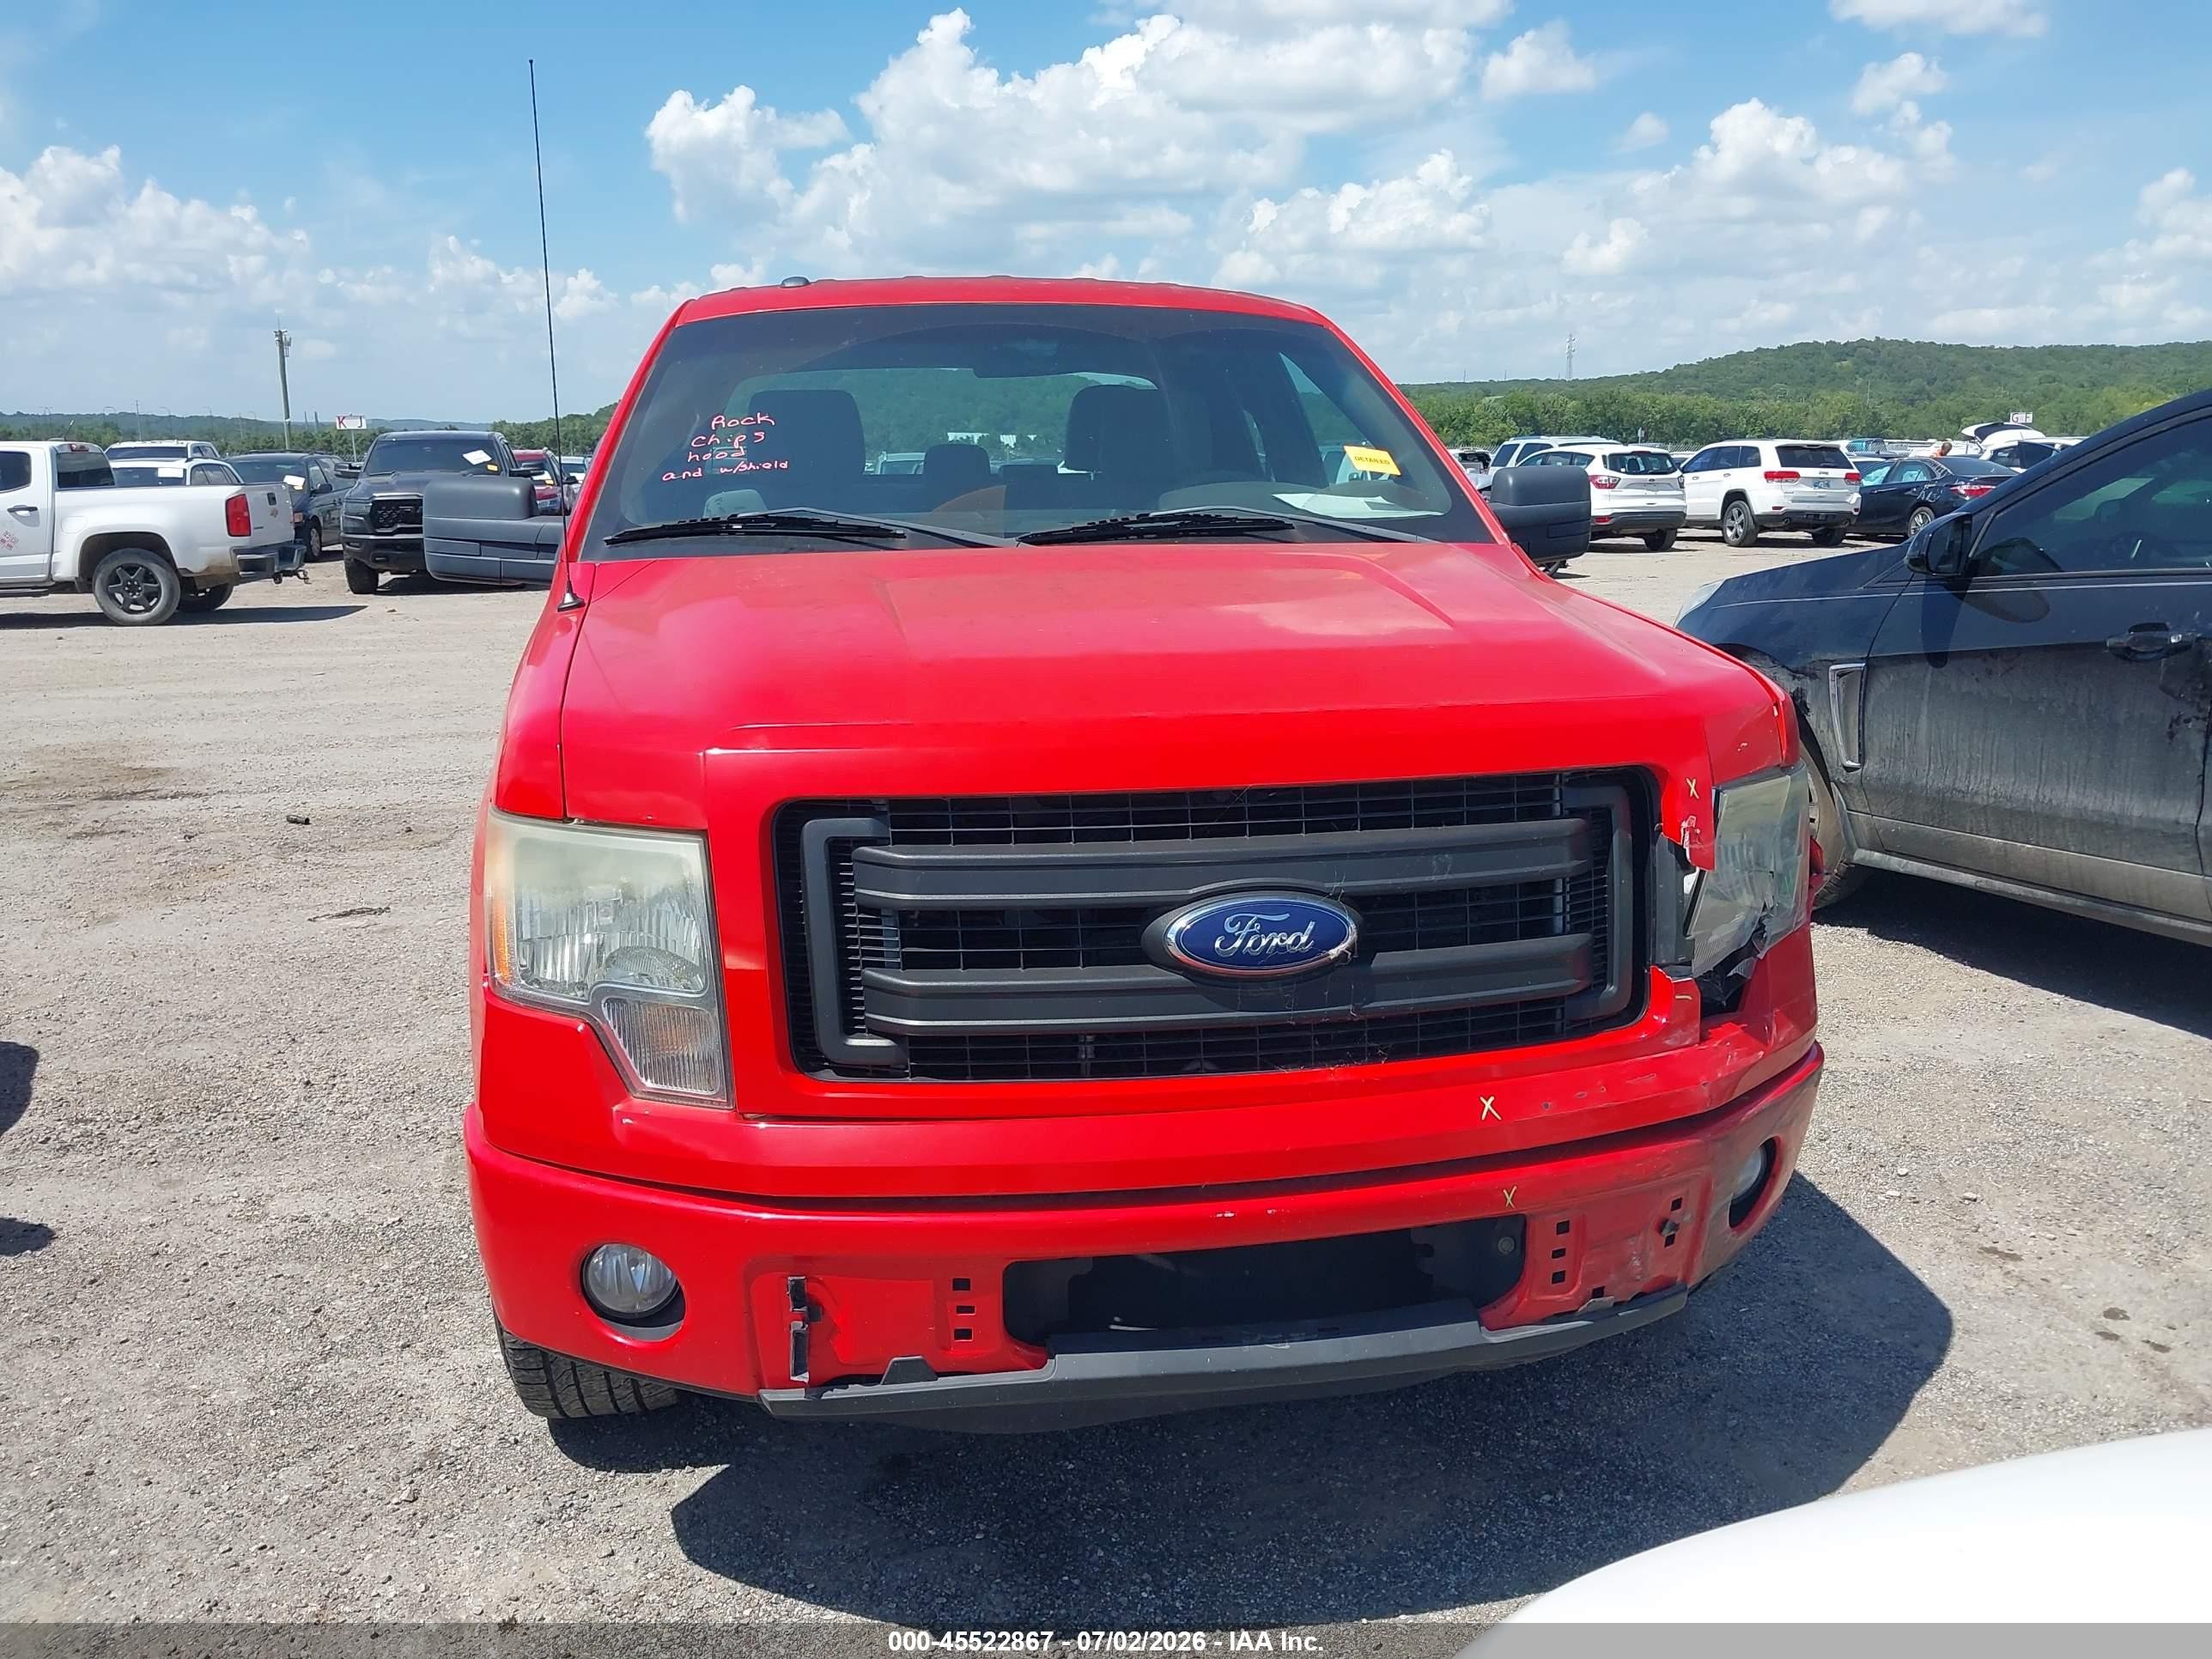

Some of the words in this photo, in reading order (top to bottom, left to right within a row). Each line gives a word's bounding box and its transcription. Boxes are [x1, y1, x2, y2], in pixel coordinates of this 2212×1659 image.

[337, 416, 347, 428] K
[357, 416, 362, 428] J
[711, 412, 775, 429] Rock
[688, 447, 745, 462] hood
[662, 468, 703, 481] and
[1214, 912, 1316, 957] Ford
